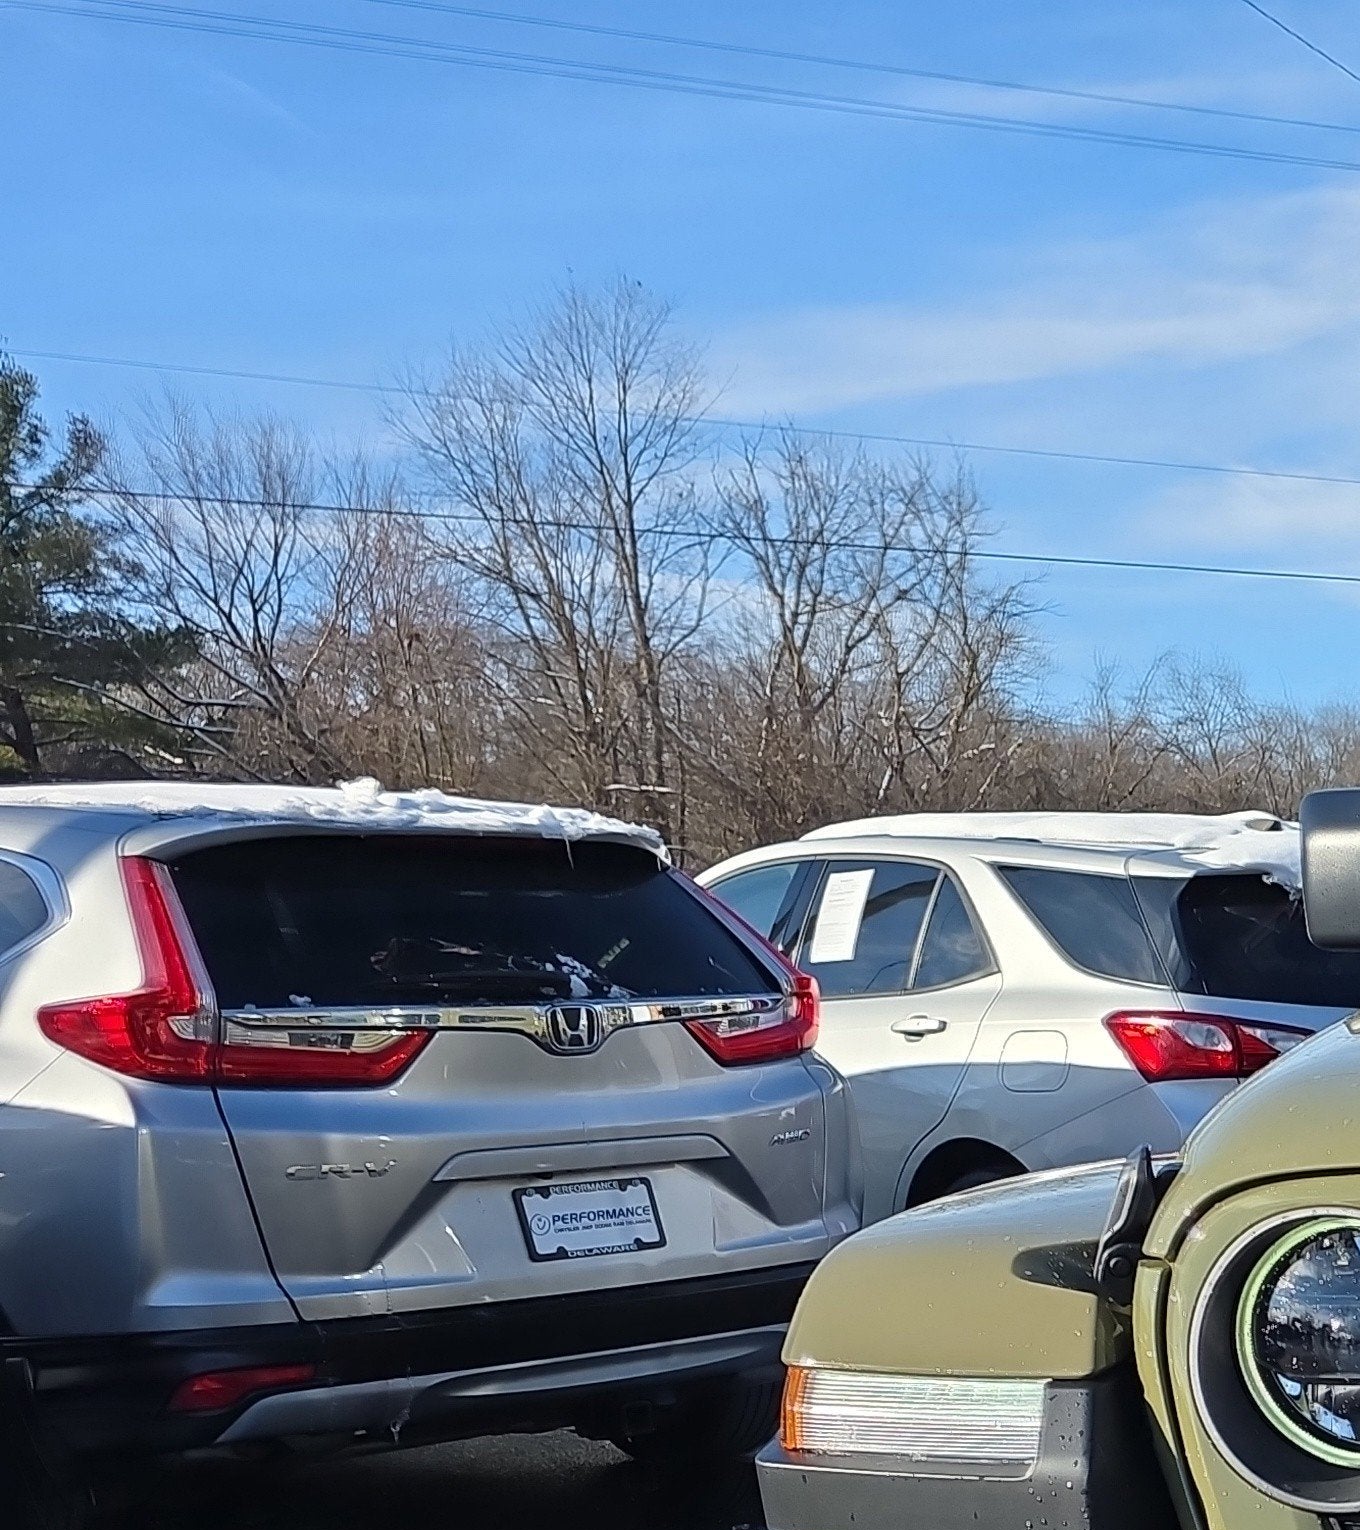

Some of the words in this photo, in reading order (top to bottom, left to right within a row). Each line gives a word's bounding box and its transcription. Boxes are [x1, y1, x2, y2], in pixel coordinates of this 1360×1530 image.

[286, 1160, 397, 1180] CR-V
[550, 1181, 619, 1195] PERFORMANCE
[552, 1205, 651, 1226] PERFORMANCE
[567, 1243, 638, 1257] DELAWARE
